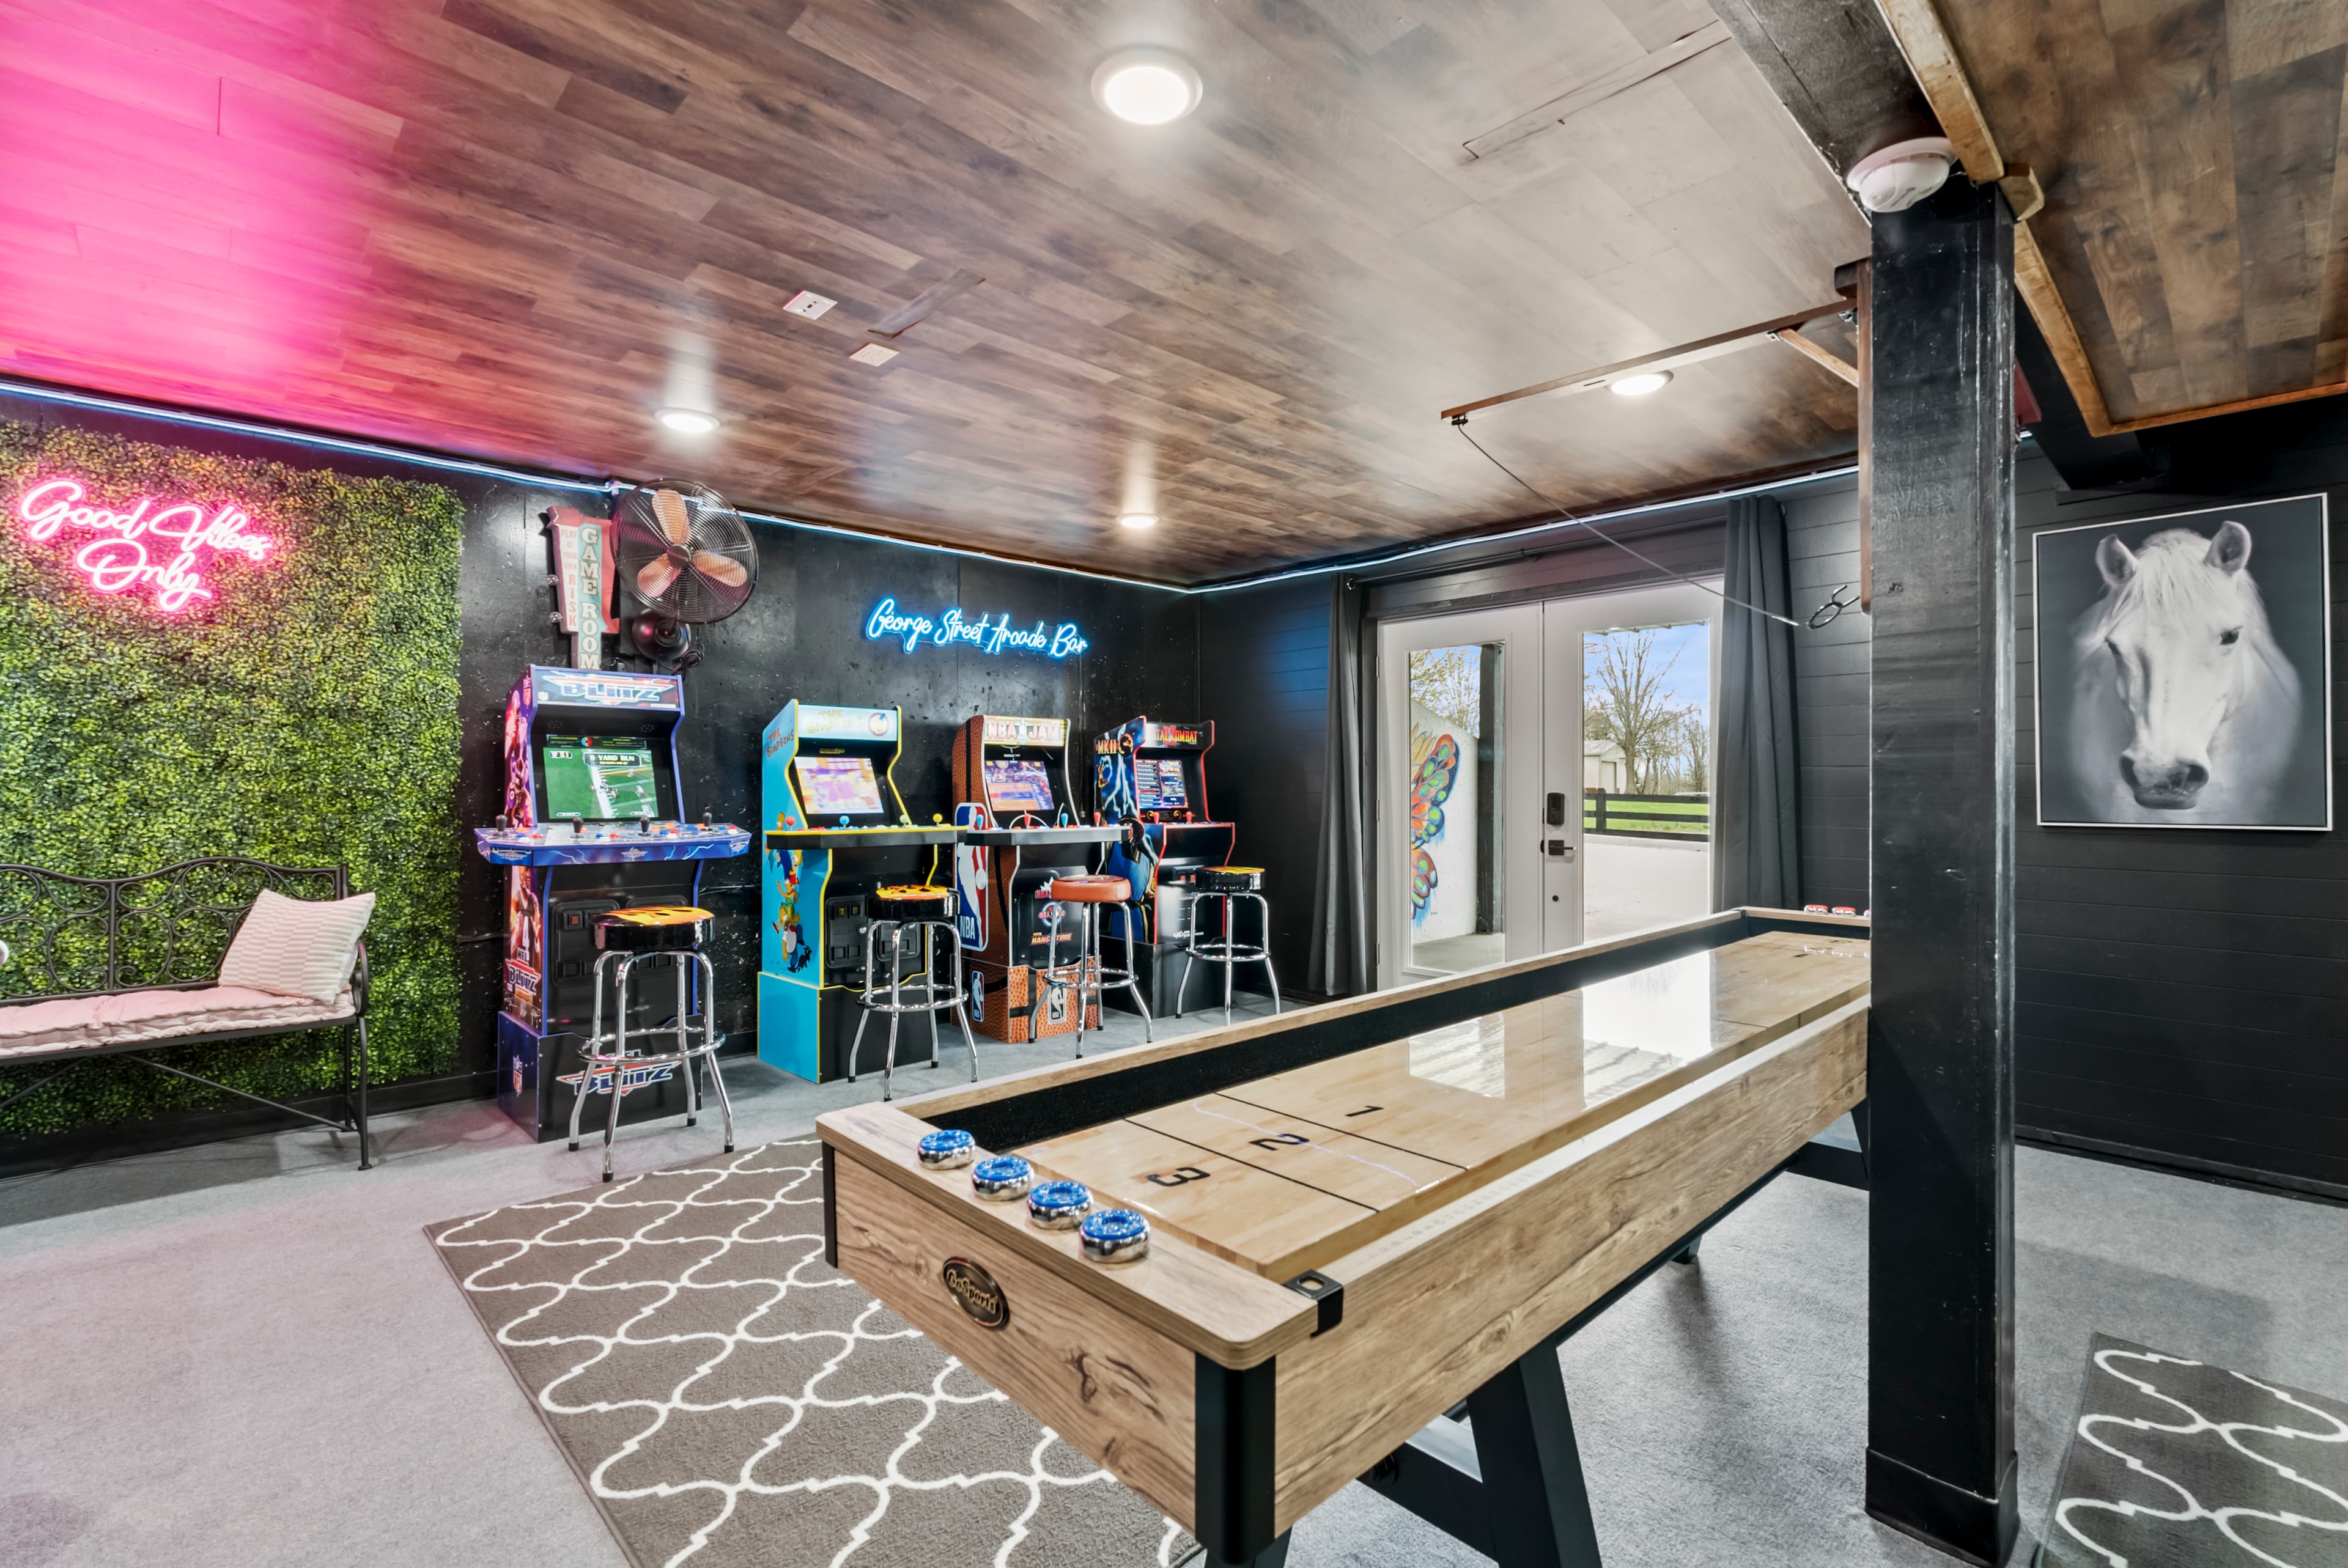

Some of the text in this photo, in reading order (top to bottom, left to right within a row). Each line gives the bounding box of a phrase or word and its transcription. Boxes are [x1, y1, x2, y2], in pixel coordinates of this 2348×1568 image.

[20, 479, 273, 561] Good Vibes
[560, 529, 577, 539] PLAY
[579, 527, 600, 596] GAME
[76, 537, 213, 611] Only
[580, 602, 600, 670] ROOM
[868, 597, 1088, 658] George Street Arcade Bar
[807, 716, 862, 734] SIMPSONS
[818, 710, 843, 720] THE
[768, 728, 780, 743] THE
[987, 721, 1061, 740] NBA JAM
[766, 729, 794, 757] SIMPSONS
[959, 915, 975, 940] NBA
[1345, 1105, 1385, 1117] 1
[1248, 1133, 1310, 1151] 2
[1145, 1166, 1211, 1187] 3
[946, 1268, 999, 1315] GoSports
